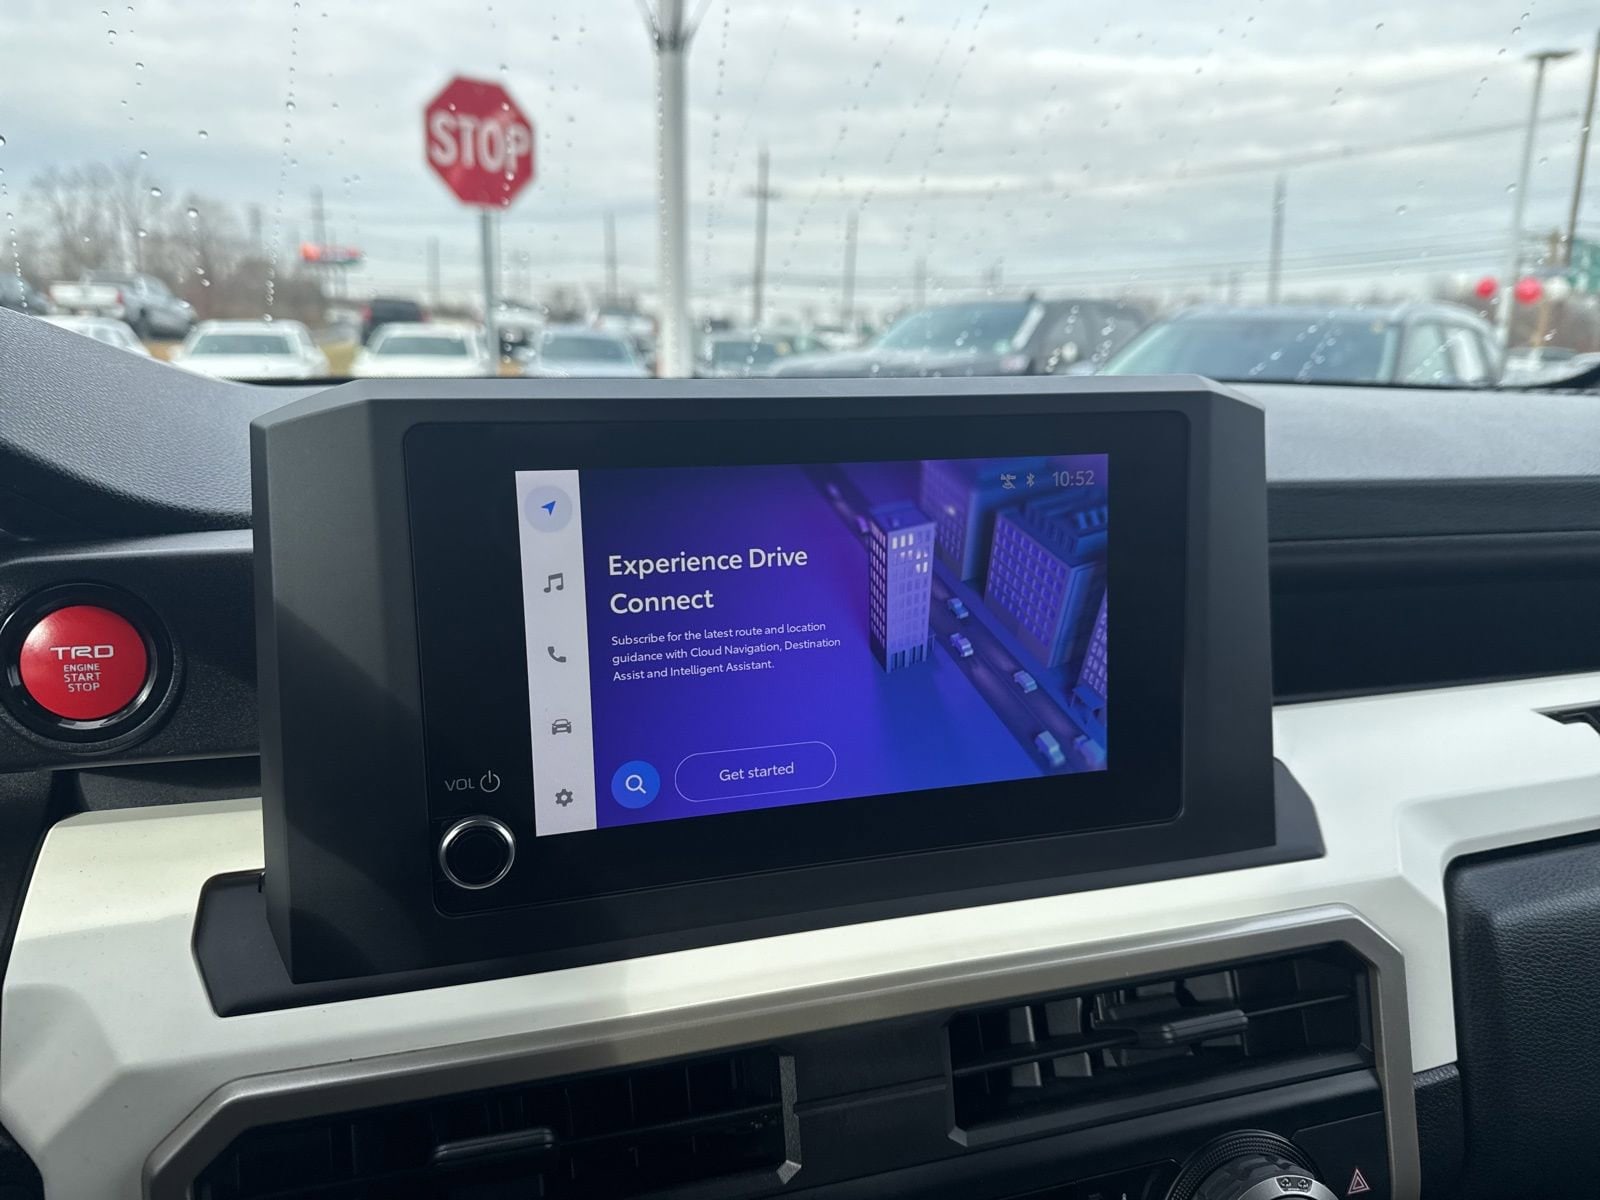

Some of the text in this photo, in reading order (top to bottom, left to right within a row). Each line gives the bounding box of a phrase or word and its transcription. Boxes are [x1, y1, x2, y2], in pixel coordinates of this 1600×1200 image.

[430, 109, 530, 174] STOP
[1052, 470, 1095, 487] 10:52
[608, 547, 808, 579] Experience Drive
[609, 590, 714, 614] Connect
[611, 622, 826, 646] Subscribe for the latest route and location
[50, 645, 114, 660] TRD
[612, 638, 841, 666] guidance with Cloud Navigation, Destination
[63, 663, 100, 672] ENGINE
[63, 672, 102, 683] START
[613, 659, 775, 682] Assist and Intelligent Assistant.
[68, 683, 100, 692] STOP
[719, 762, 794, 782] Get started
[445, 777, 475, 792] VOL
